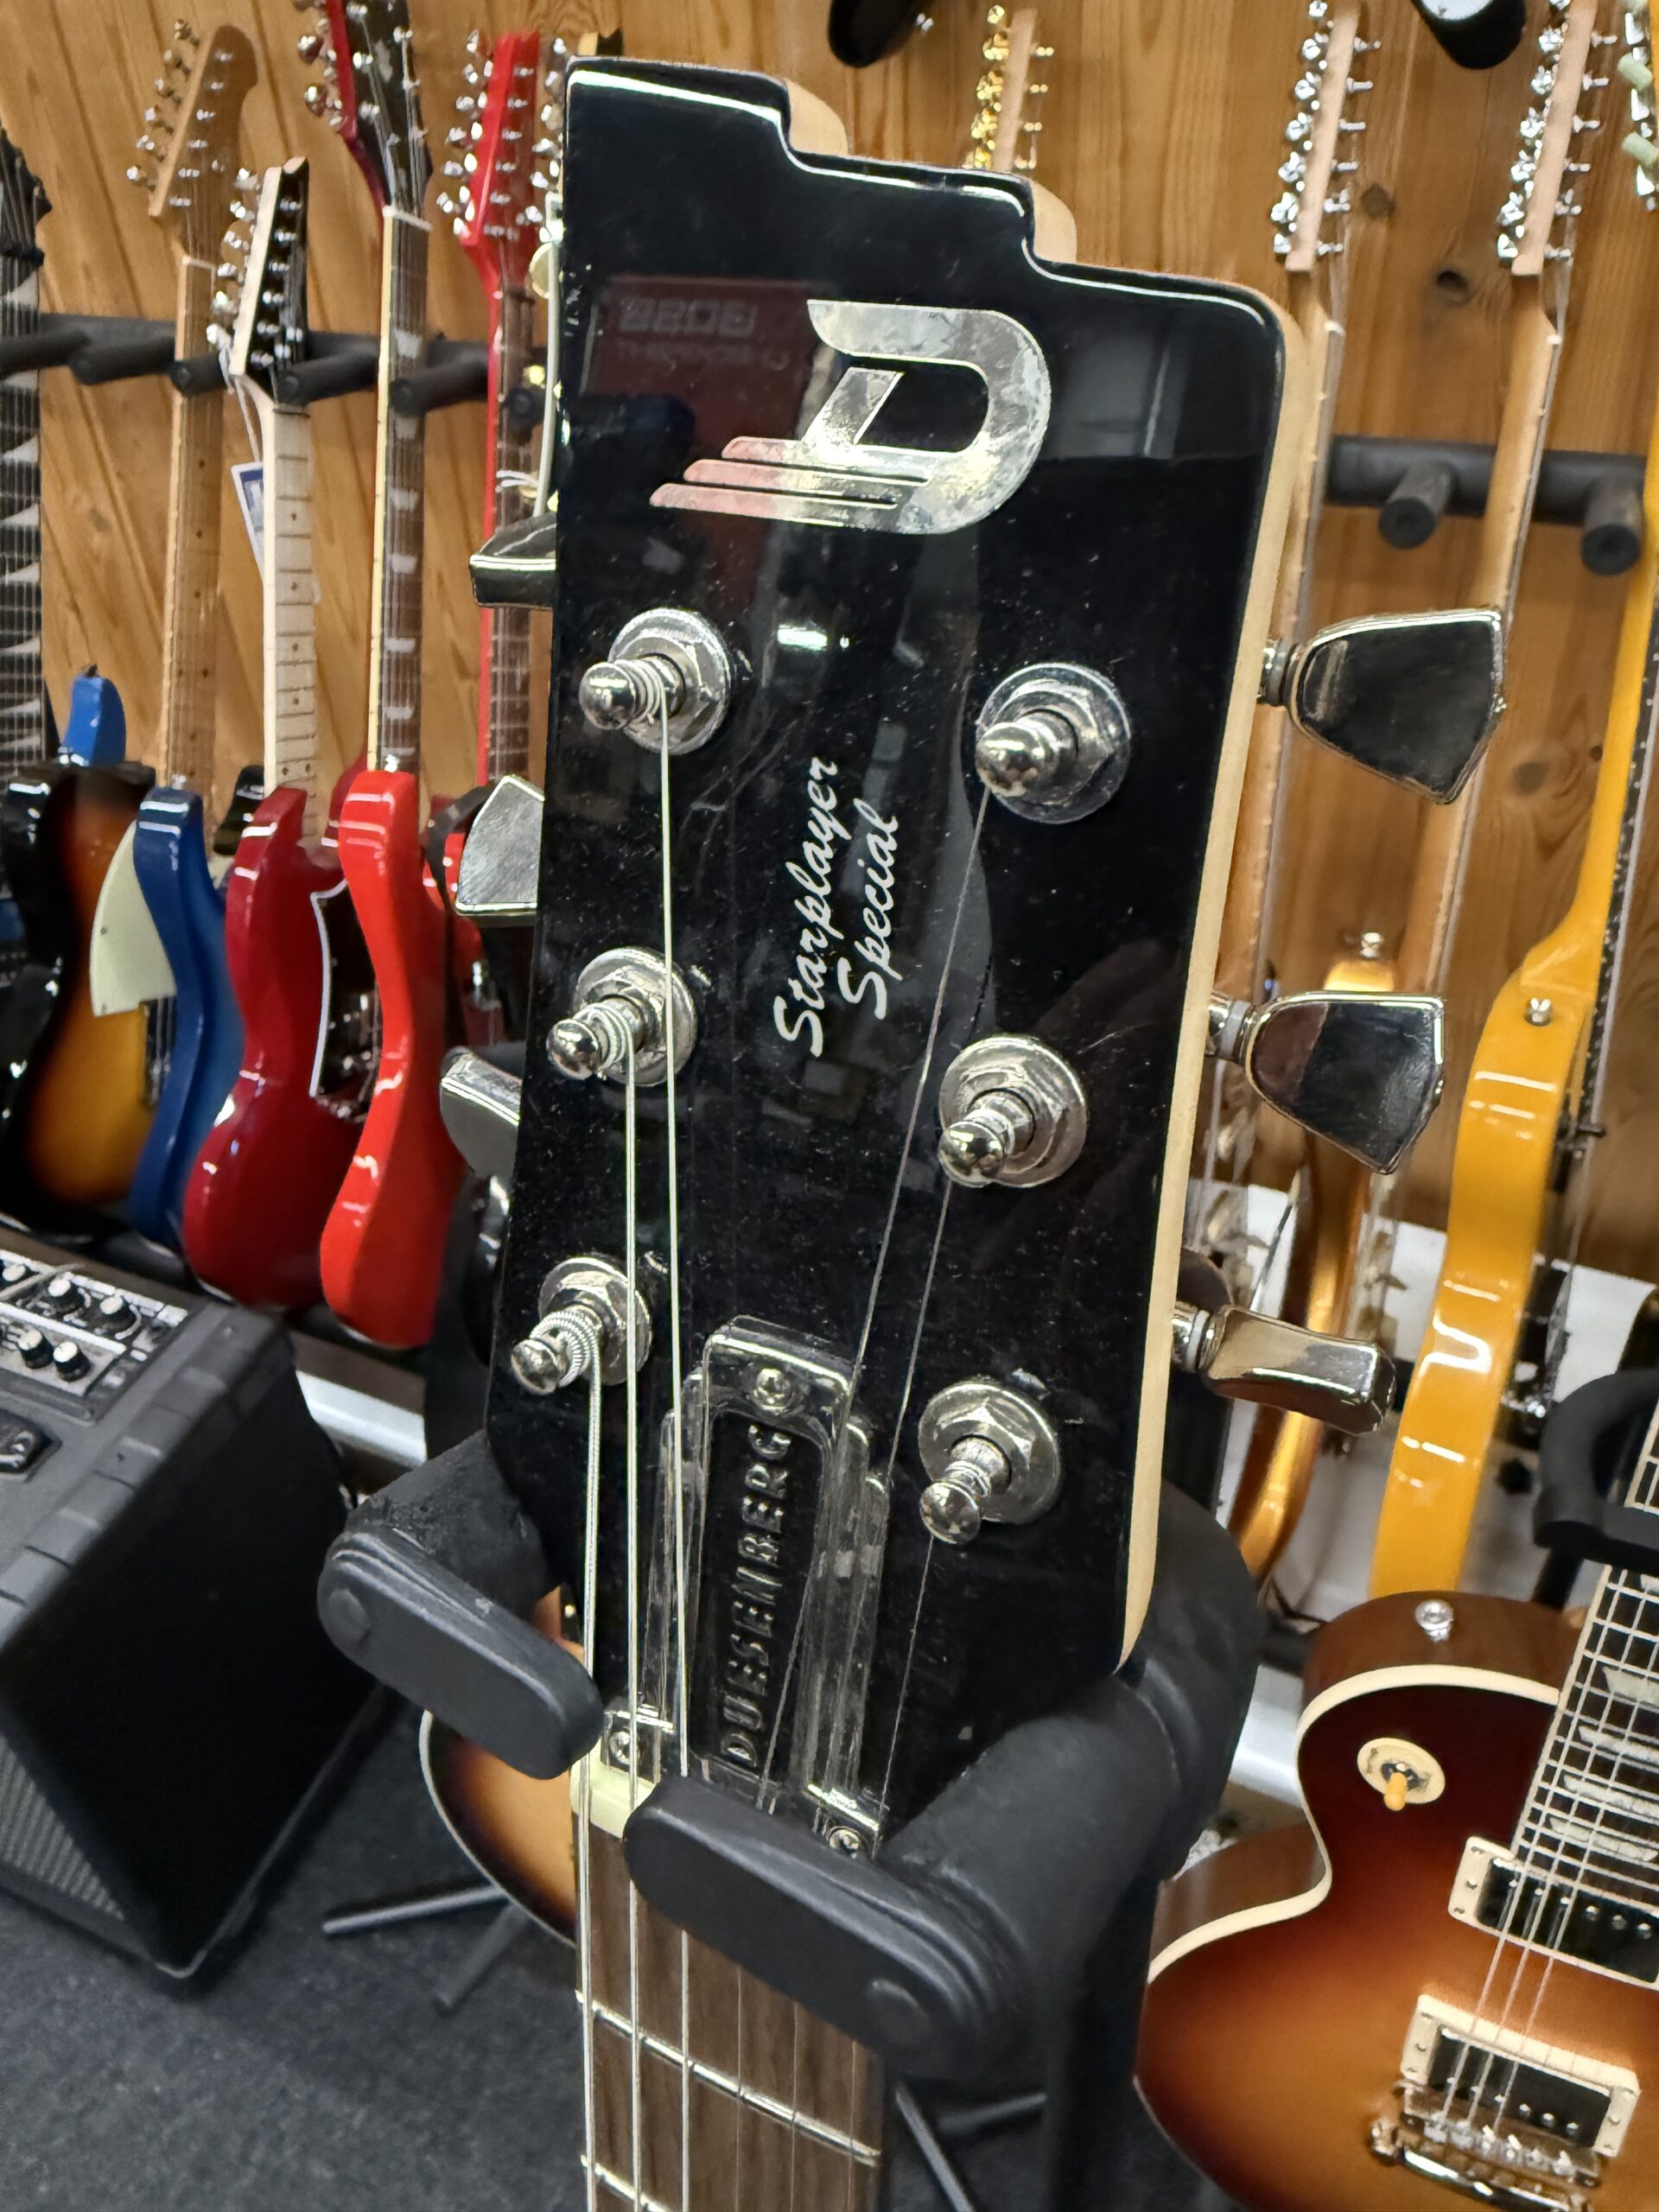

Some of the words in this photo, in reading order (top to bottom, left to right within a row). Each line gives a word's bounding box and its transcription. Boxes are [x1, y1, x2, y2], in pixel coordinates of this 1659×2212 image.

[773, 757, 851, 1058] Starplayer
[837, 798, 903, 1020] Special
[720, 1424, 791, 1769] DUESENBERG
